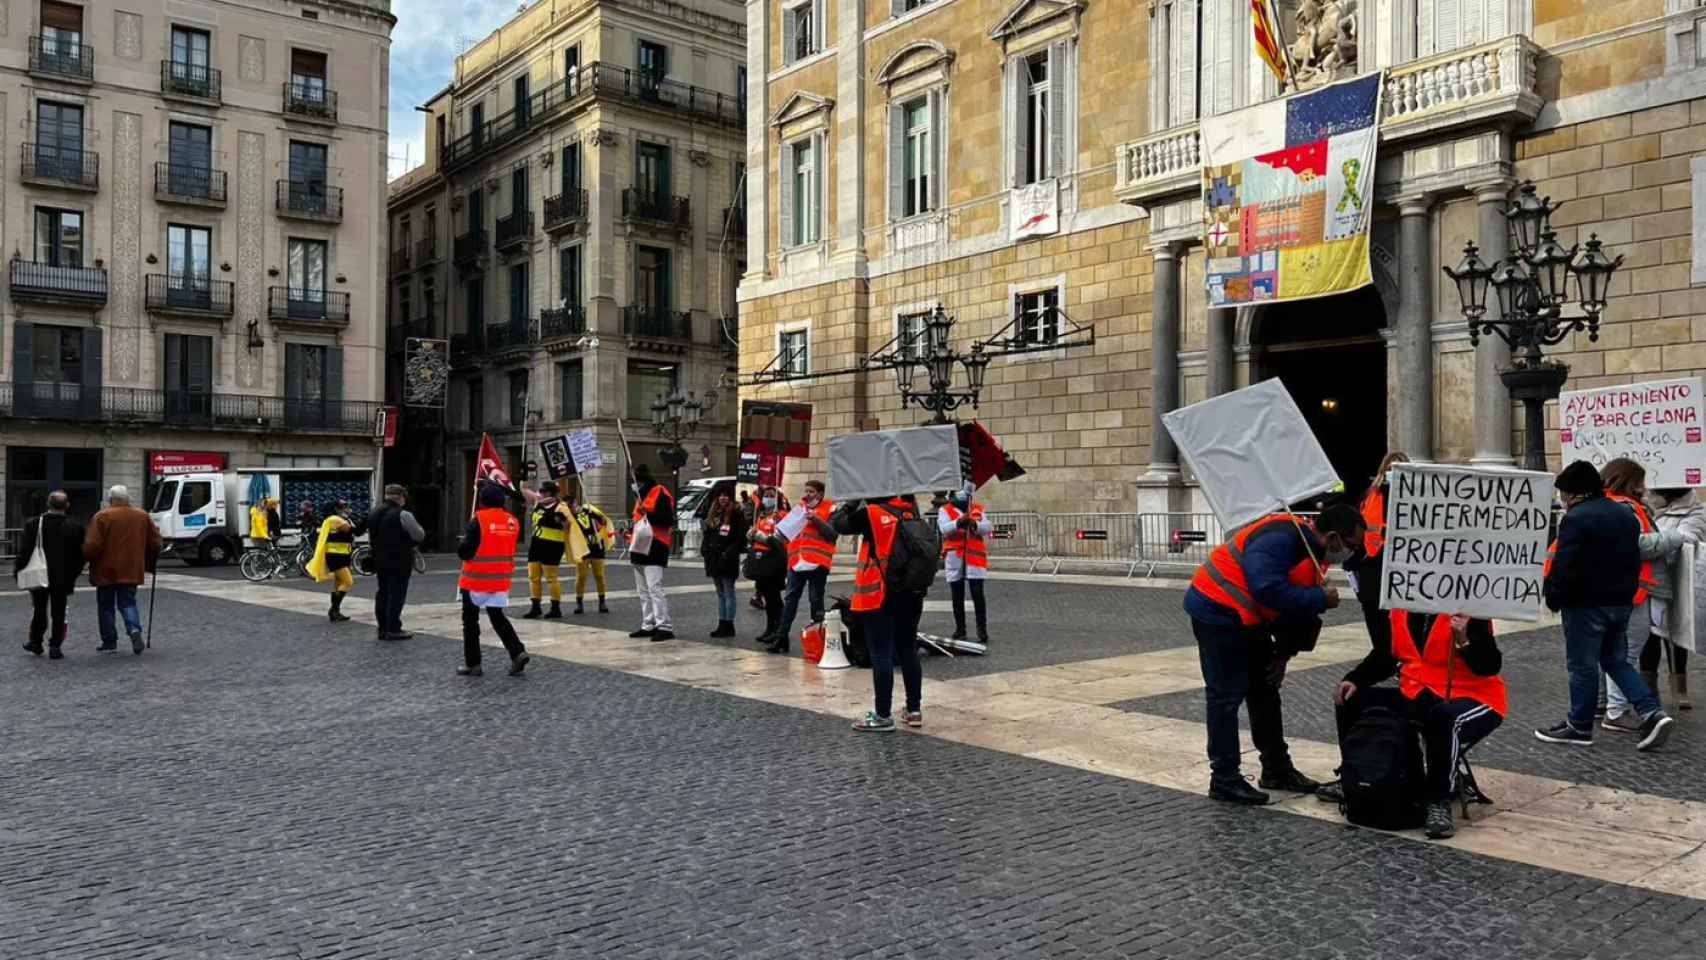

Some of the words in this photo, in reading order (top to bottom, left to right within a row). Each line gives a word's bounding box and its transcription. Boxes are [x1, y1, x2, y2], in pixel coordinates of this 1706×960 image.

[1565, 384, 1692, 413] AYUNTAMIENTO
[1565, 414, 1586, 427] DE
[1591, 406, 1697, 427] BARCELONA
[1399, 471, 1534, 504] NINGUNA
[1395, 502, 1547, 531] ENFERMEDAD
[1391, 536, 1545, 565] PROFESIONAL
[1388, 570, 1542, 603] RECONOCIDA
